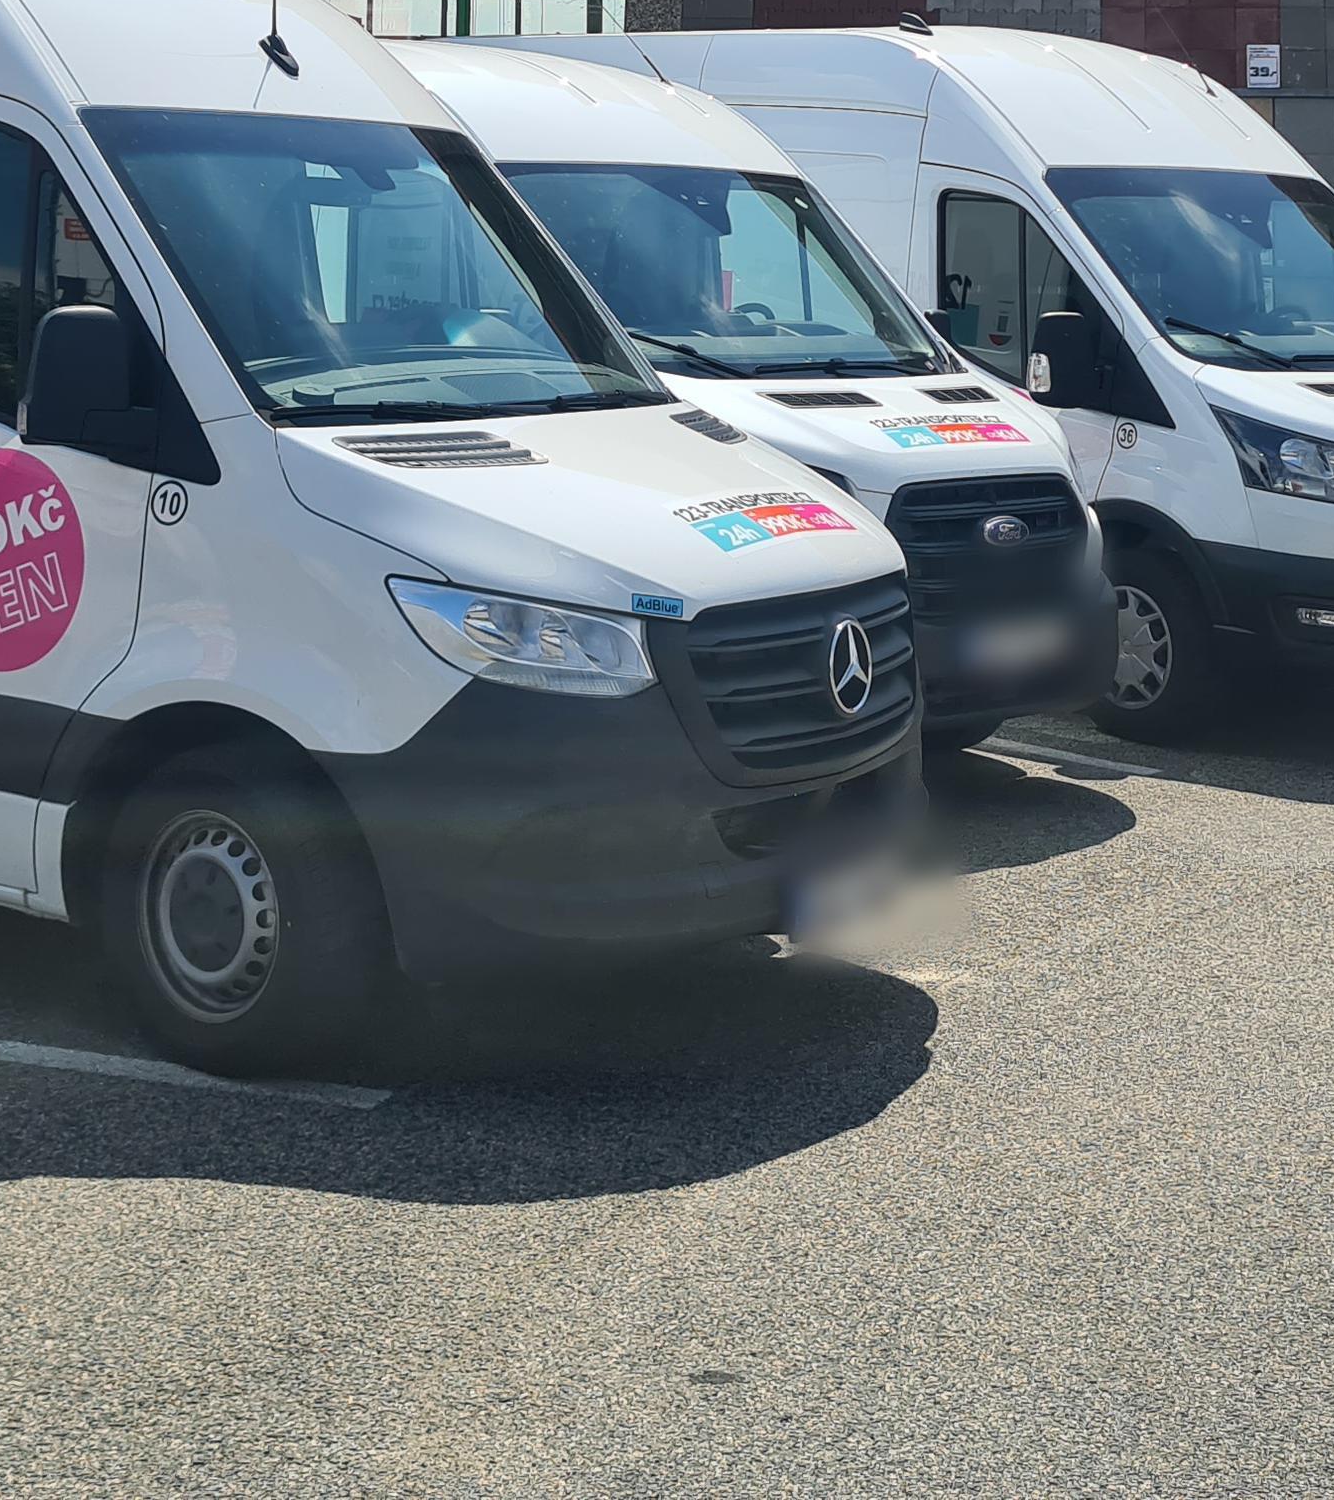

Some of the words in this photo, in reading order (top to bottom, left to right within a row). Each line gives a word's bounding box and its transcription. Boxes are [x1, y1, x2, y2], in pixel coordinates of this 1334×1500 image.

[1120, 426, 1135, 444] 36
[158, 489, 182, 516] 10
[719, 523, 762, 547] 24h
[635, 596, 680, 614] AdBlue
